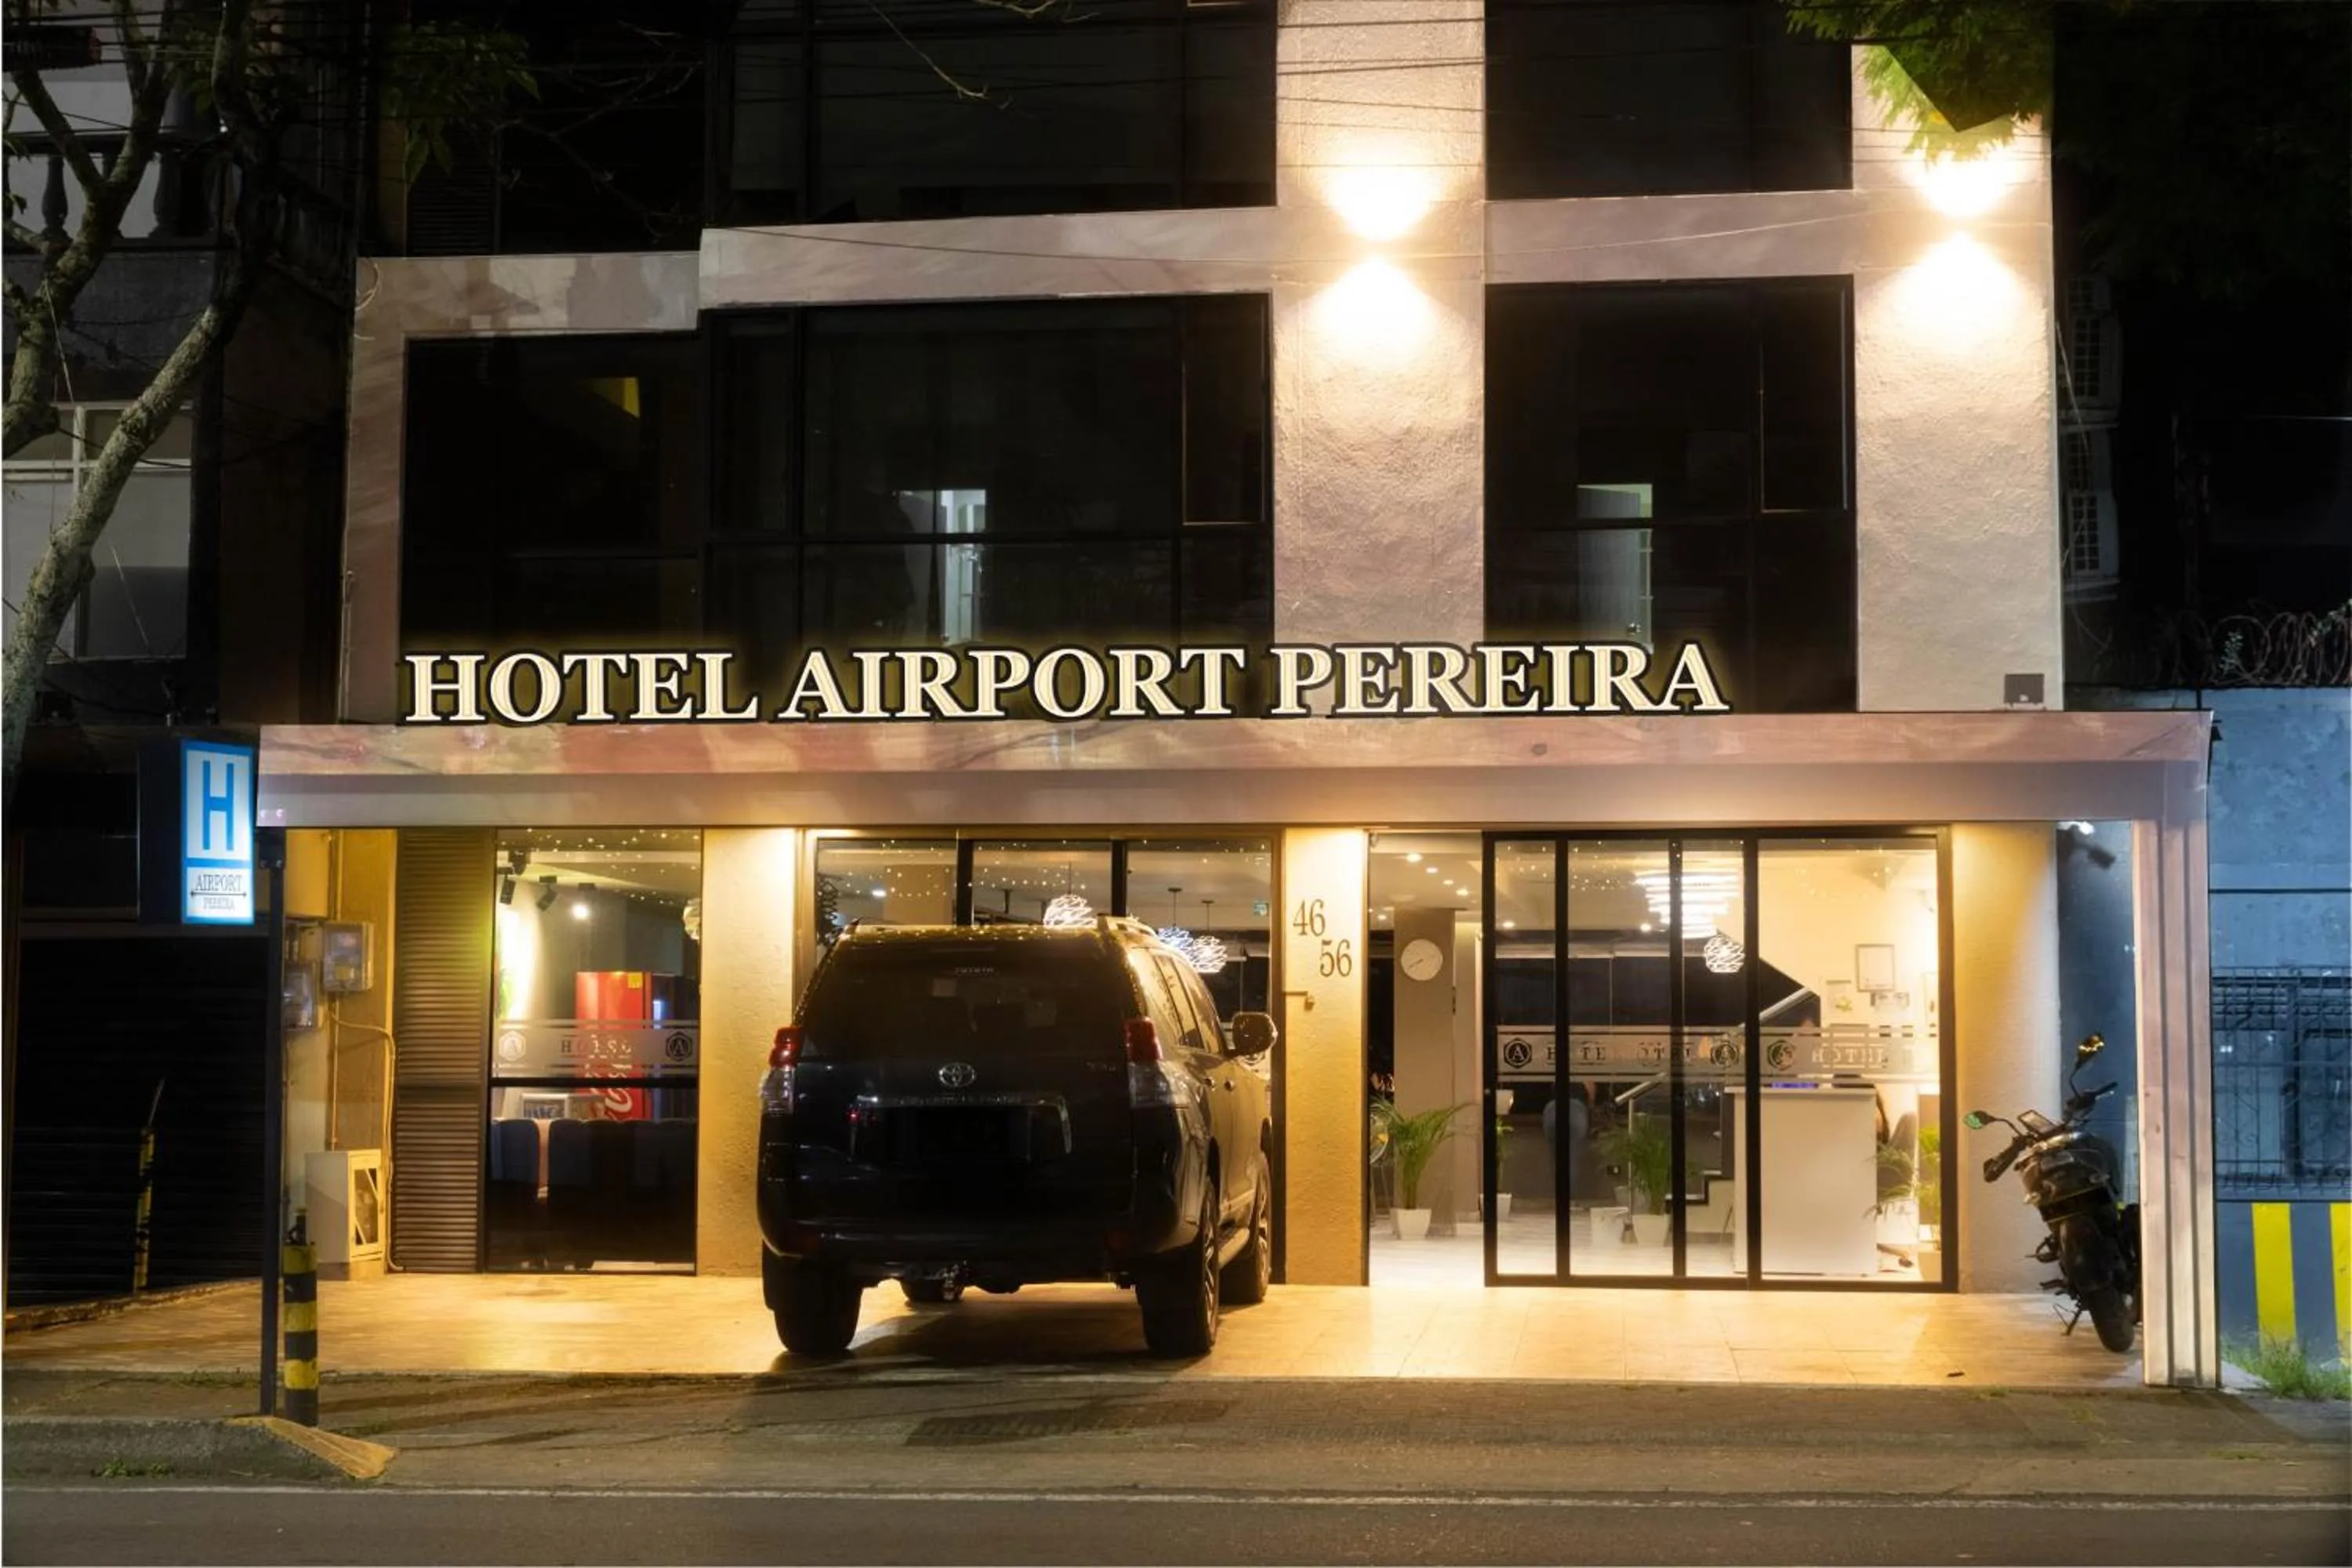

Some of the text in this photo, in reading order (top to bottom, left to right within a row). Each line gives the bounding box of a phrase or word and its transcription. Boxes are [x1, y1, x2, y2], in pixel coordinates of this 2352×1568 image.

[403, 642, 1731, 723] HOTEL AIRPORT PEREIRA
[202, 760, 234, 851] H
[195, 873, 243, 891] AIRPORT
[1292, 898, 1326, 937] 46
[1319, 938, 1352, 978] 56
